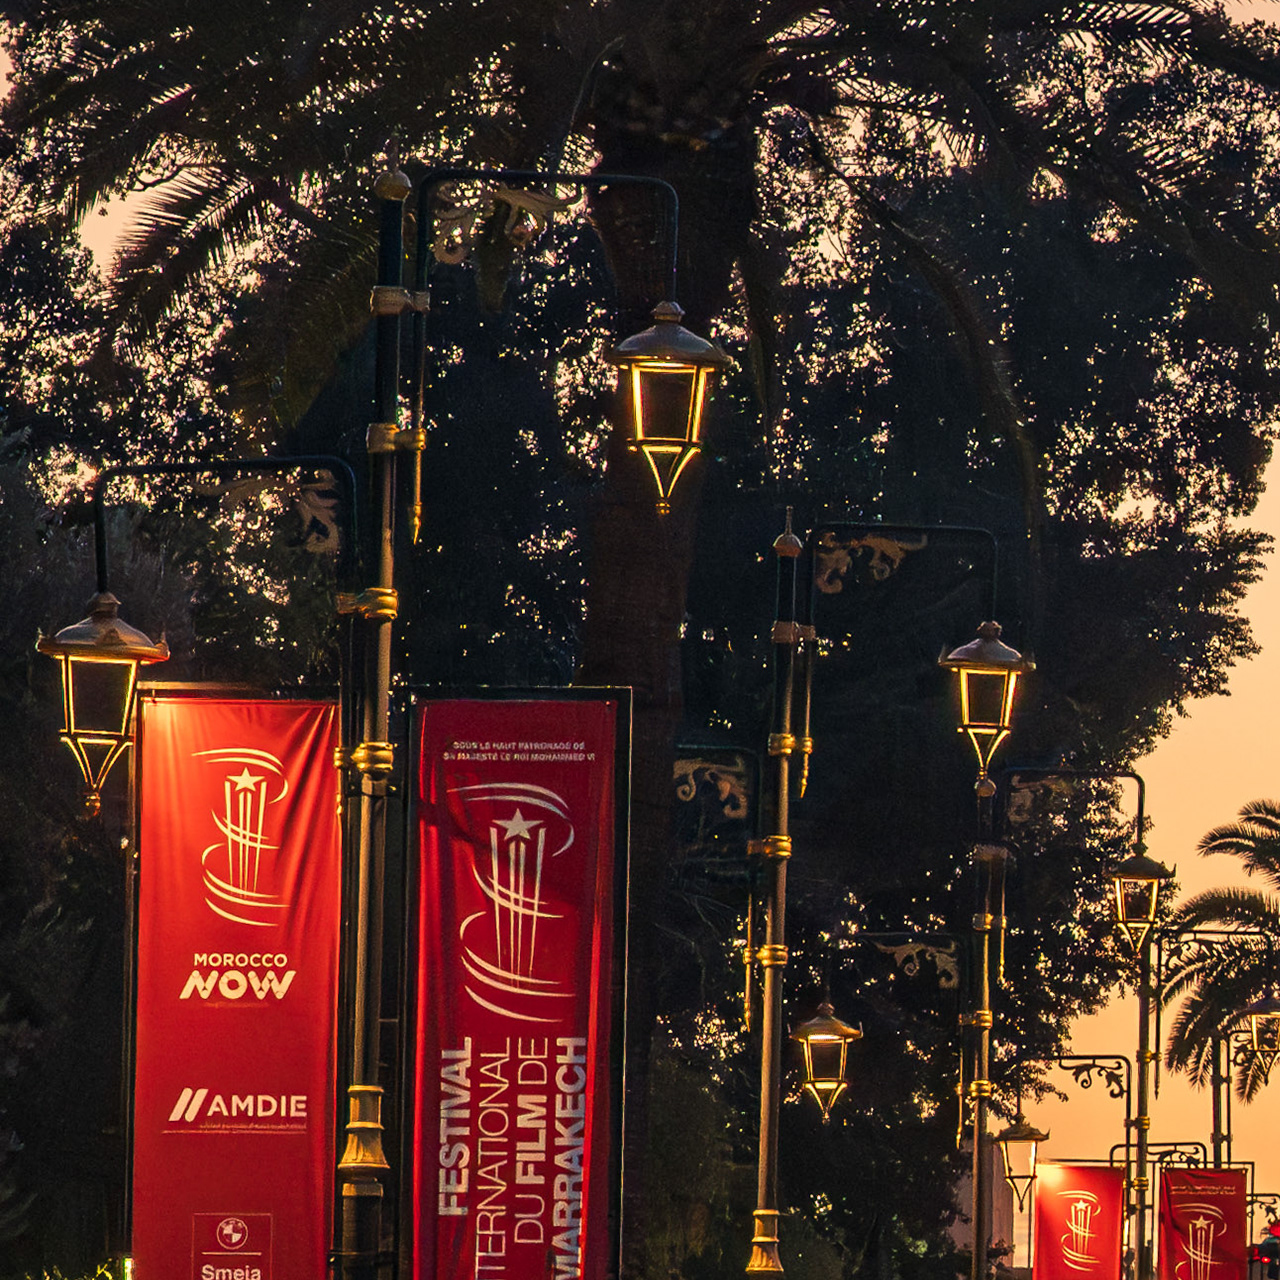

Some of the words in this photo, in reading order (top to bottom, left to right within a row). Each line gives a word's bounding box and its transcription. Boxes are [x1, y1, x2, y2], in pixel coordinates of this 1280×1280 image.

[194, 953, 288, 967] MOROCCO
[179, 970, 297, 1000] NOW
[518, 1036, 548, 1085] DE
[207, 1094, 308, 1118] AMDIE
[438, 1036, 472, 1216] FESTIVAL
[515, 1094, 547, 1185] FILM
[514, 1193, 545, 1244] DU
